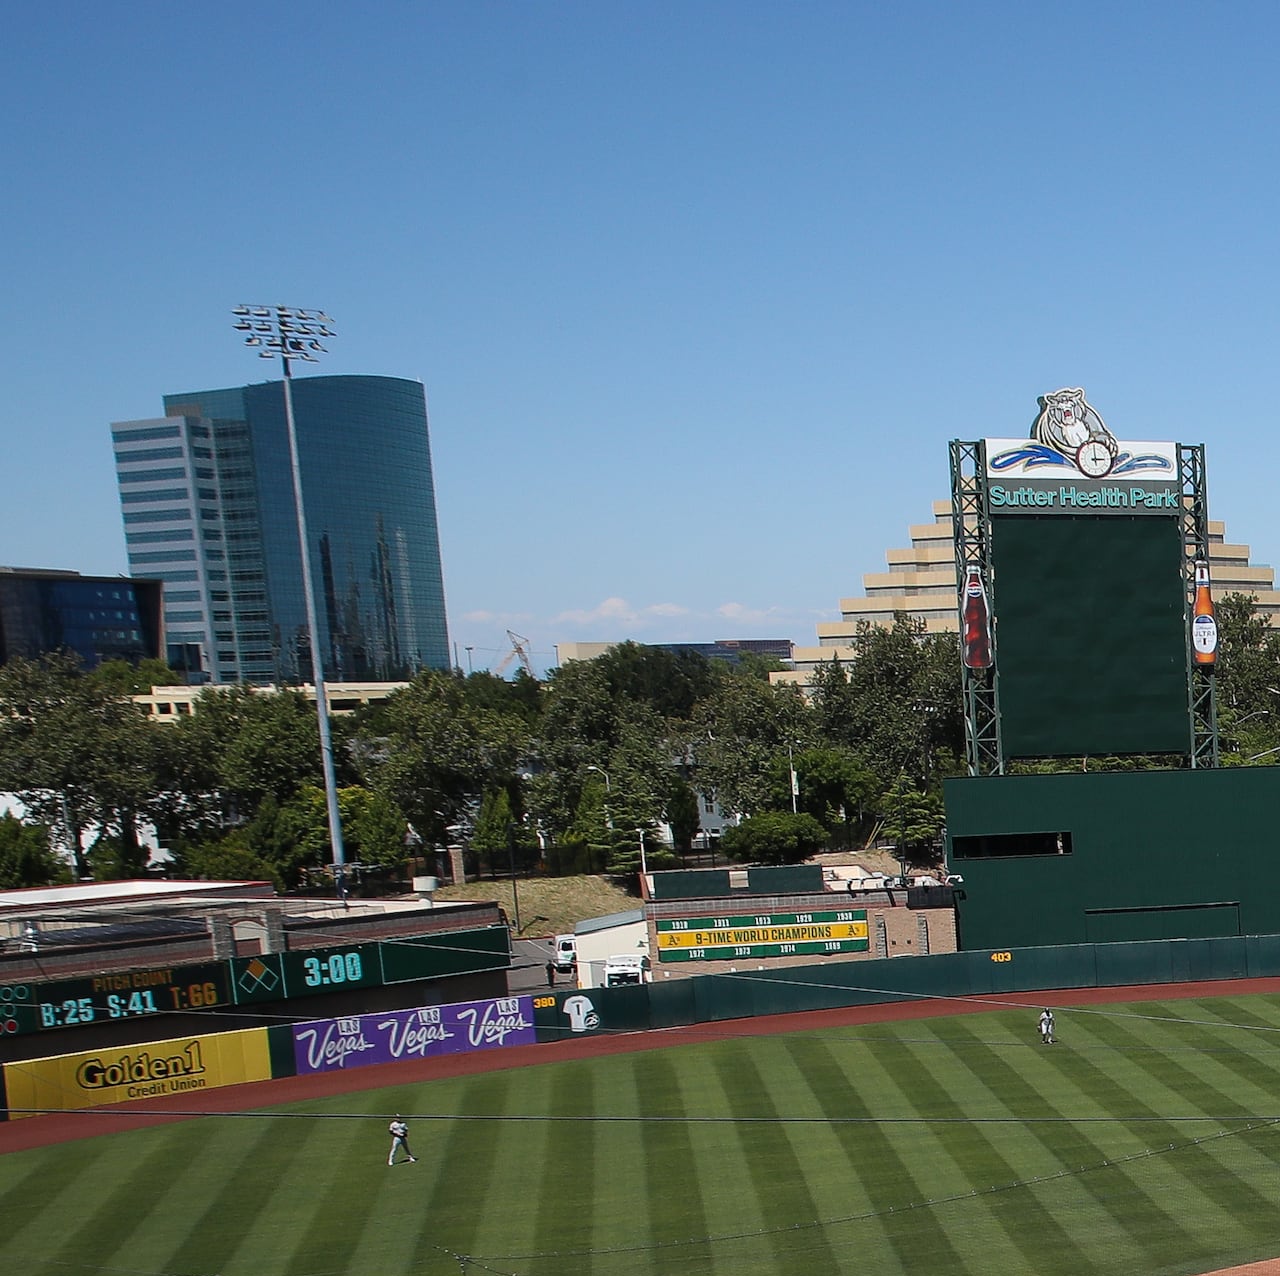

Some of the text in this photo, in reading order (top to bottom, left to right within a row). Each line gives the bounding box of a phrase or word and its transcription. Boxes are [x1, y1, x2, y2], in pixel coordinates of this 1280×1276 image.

[989, 485, 1179, 508] Sutter Health Park
[696, 926, 832, 945] 9-TIME WORLD CHAMPIONS
[304, 952, 361, 987] 3:00
[93, 970, 173, 992] PITCH COUNT
[41, 982, 217, 1027] B:25 S:41 T:66
[496, 998, 518, 1016] LAS
[533, 996, 555, 1009] 380
[337, 1018, 360, 1035] LAS
[418, 1008, 440, 1025] LAS
[457, 1003, 532, 1046] Vegas
[378, 1010, 454, 1057] Vegas
[296, 1022, 375, 1068] Vegas
[127, 1078, 206, 1098] Credit Union
